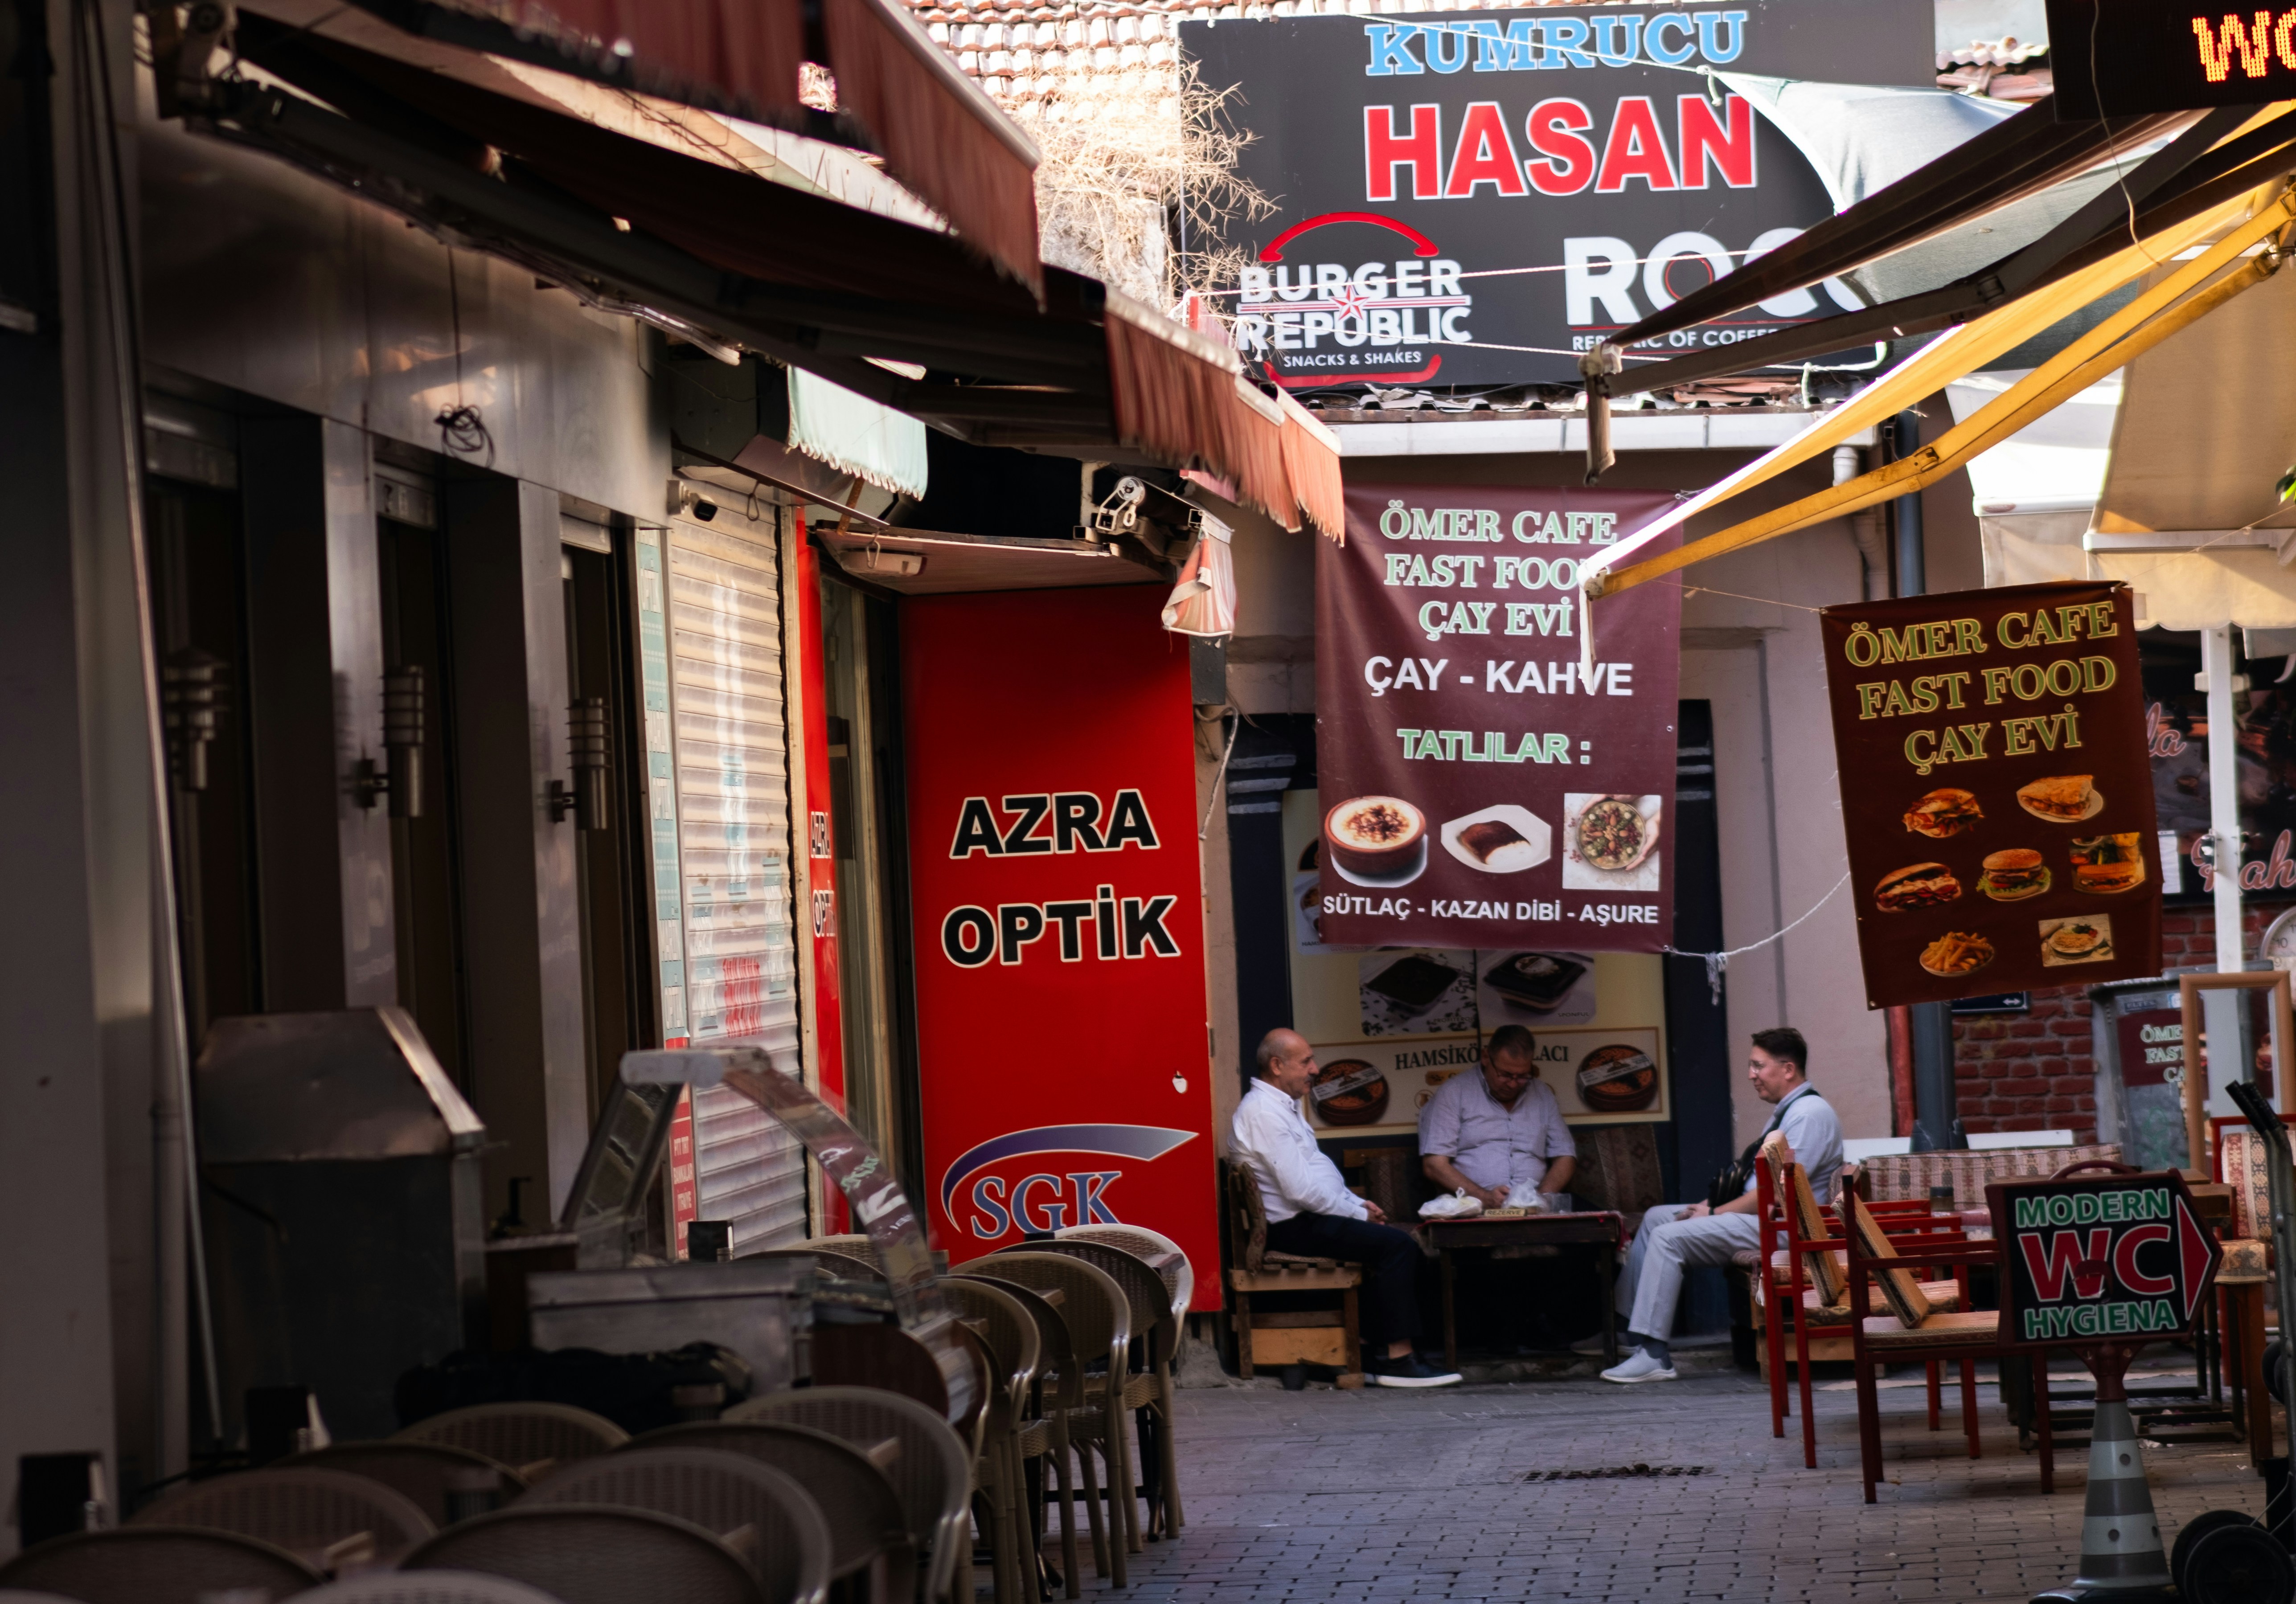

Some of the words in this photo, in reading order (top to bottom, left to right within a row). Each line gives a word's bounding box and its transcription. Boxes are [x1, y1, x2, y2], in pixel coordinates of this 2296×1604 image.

[1365, 9, 1748, 77] KUMRUCU
[1364, 94, 1757, 202] HASAN
[1240, 259, 1462, 303] BURGER
[1236, 306, 1472, 351] REPUBLIC
[1669, 330, 1699, 347] OF
[1283, 354, 1345, 367] SNACKS
[1349, 355, 1359, 365] &
[1365, 351, 1421, 364] SHAKES
[1380, 499, 1504, 542] ÖMER
[1512, 511, 1617, 545] CAFE
[1384, 553, 1485, 587] FAST
[1493, 556, 1610, 589] FOO
[1419, 600, 1496, 641] ÇAY
[1505, 596, 1573, 636] EVİ
[1844, 618, 1987, 667] ÖMER
[1997, 600, 2119, 649] CAFE
[1364, 656, 1448, 696] ÇAY
[1856, 672, 1970, 720] FAST
[1981, 655, 2117, 705] FOOD
[1397, 728, 1571, 764] TATLILAR
[1904, 722, 1991, 776] ÇAY
[2001, 703, 2081, 757] EVİ
[2146, 702, 2187, 757] la
[811, 811, 832, 859] AZRA
[949, 789, 1161, 859] AZRA
[941, 884, 1181, 968] OPTİK
[1323, 893, 1410, 920] SÜTLAÇ
[1431, 900, 1509, 920] KAZAN
[1516, 899, 1561, 921] DİBİ
[1579, 905, 1659, 927] AŞURE
[2140, 1024, 2183, 1043] ÖME
[1395, 1043, 1482, 1070] HAMSİKÖ
[970, 1171, 1122, 1240] SGK
[2015, 1188, 2170, 1228] MODERN
[2018, 1223, 2177, 1302] WC
[2024, 1300, 2178, 1339] HYGIENA
